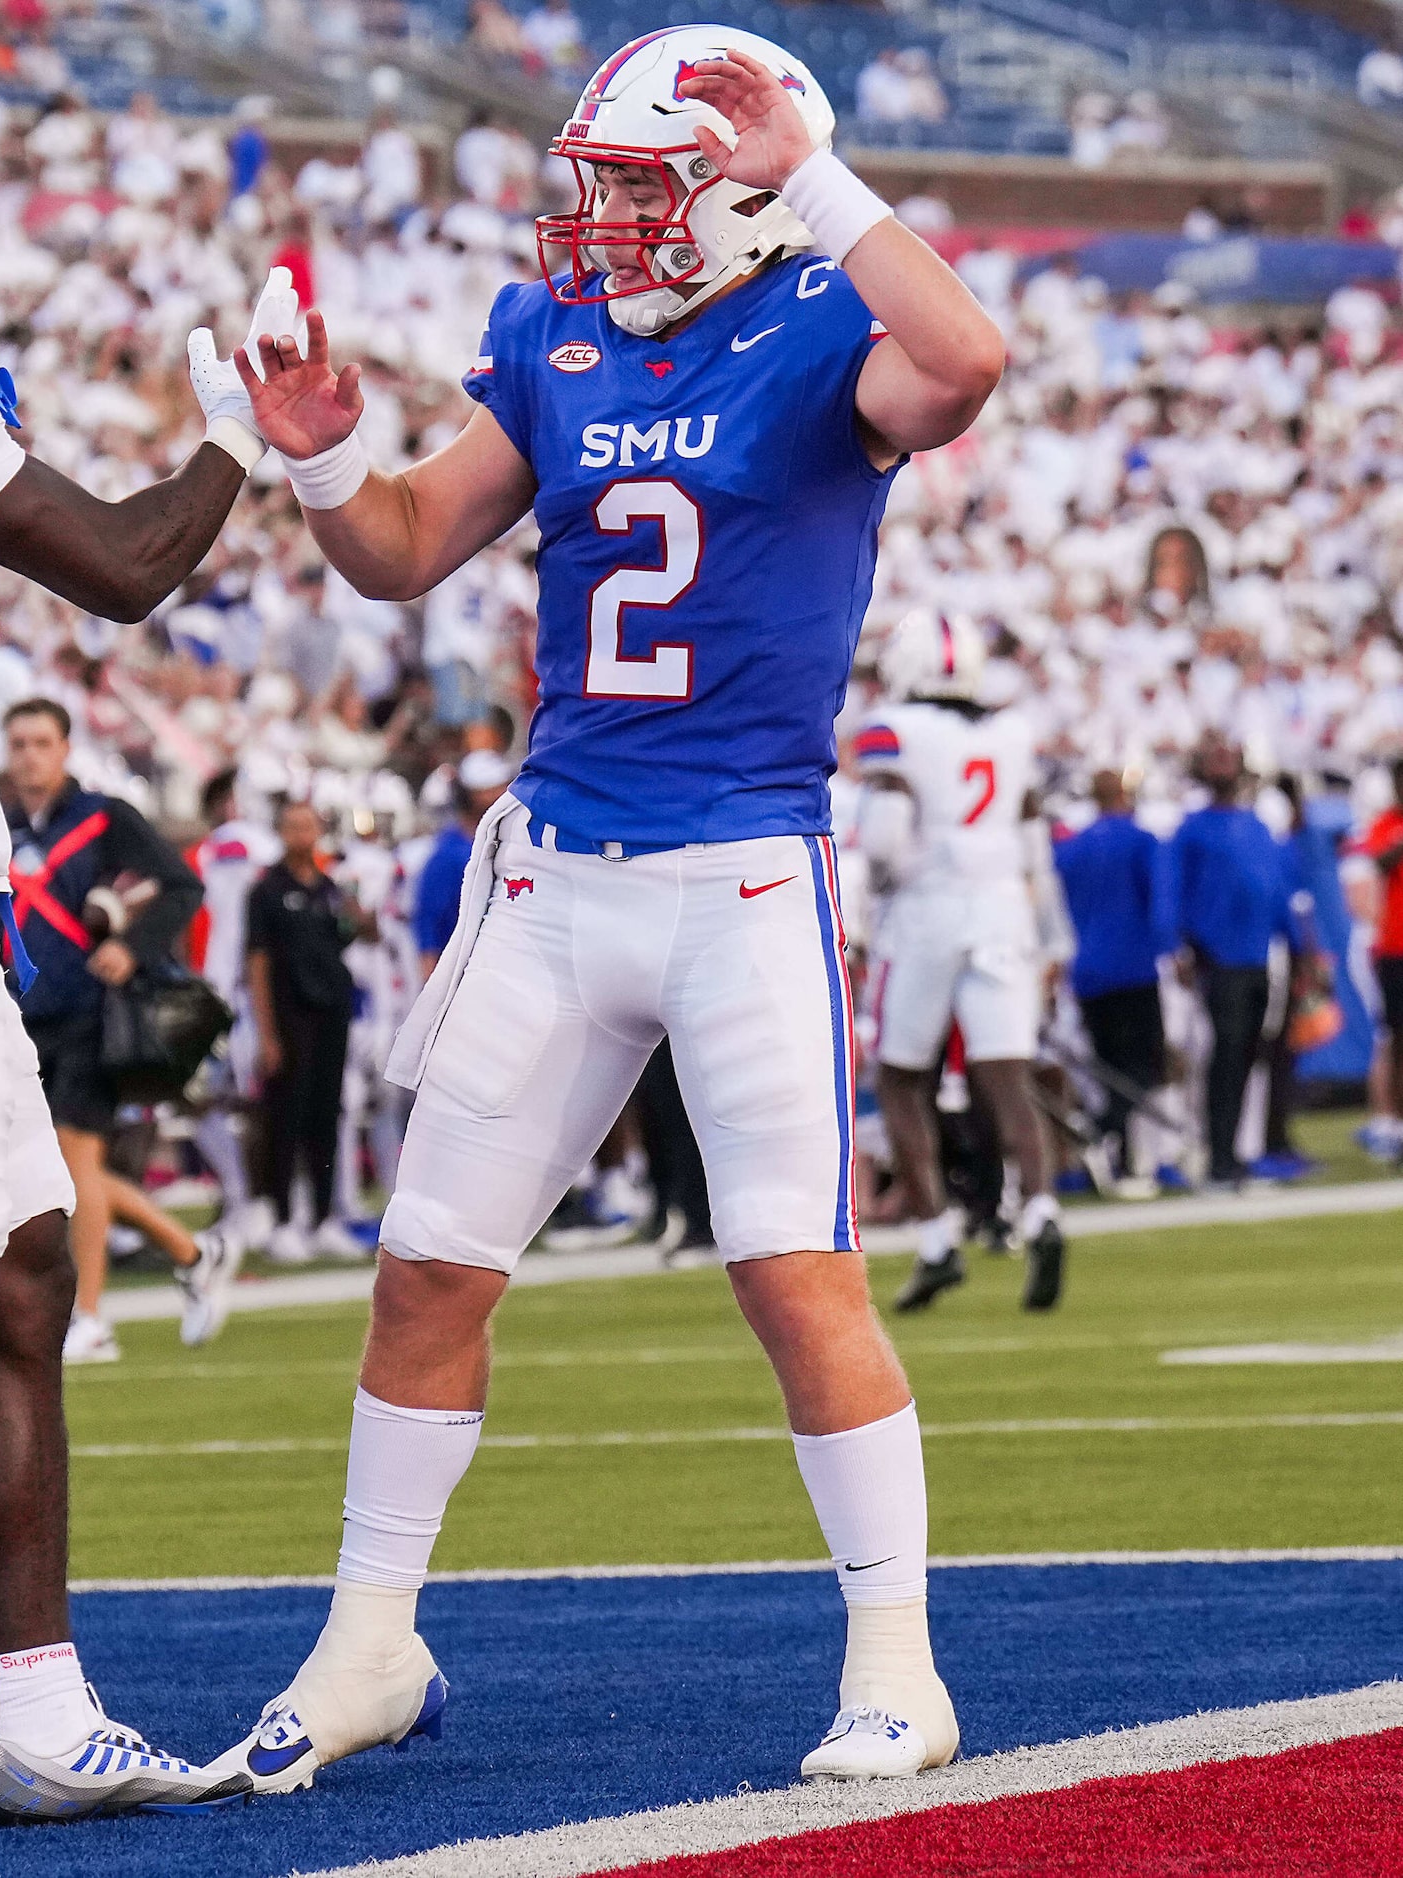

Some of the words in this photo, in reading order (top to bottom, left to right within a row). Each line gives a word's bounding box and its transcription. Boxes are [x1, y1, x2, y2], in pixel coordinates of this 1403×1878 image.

[796, 260, 835, 299] C
[555, 349, 595, 361] ACC
[579, 414, 719, 468] SMU
[583, 476, 703, 701] 2
[0, 1648, 74, 1669] Supreme
